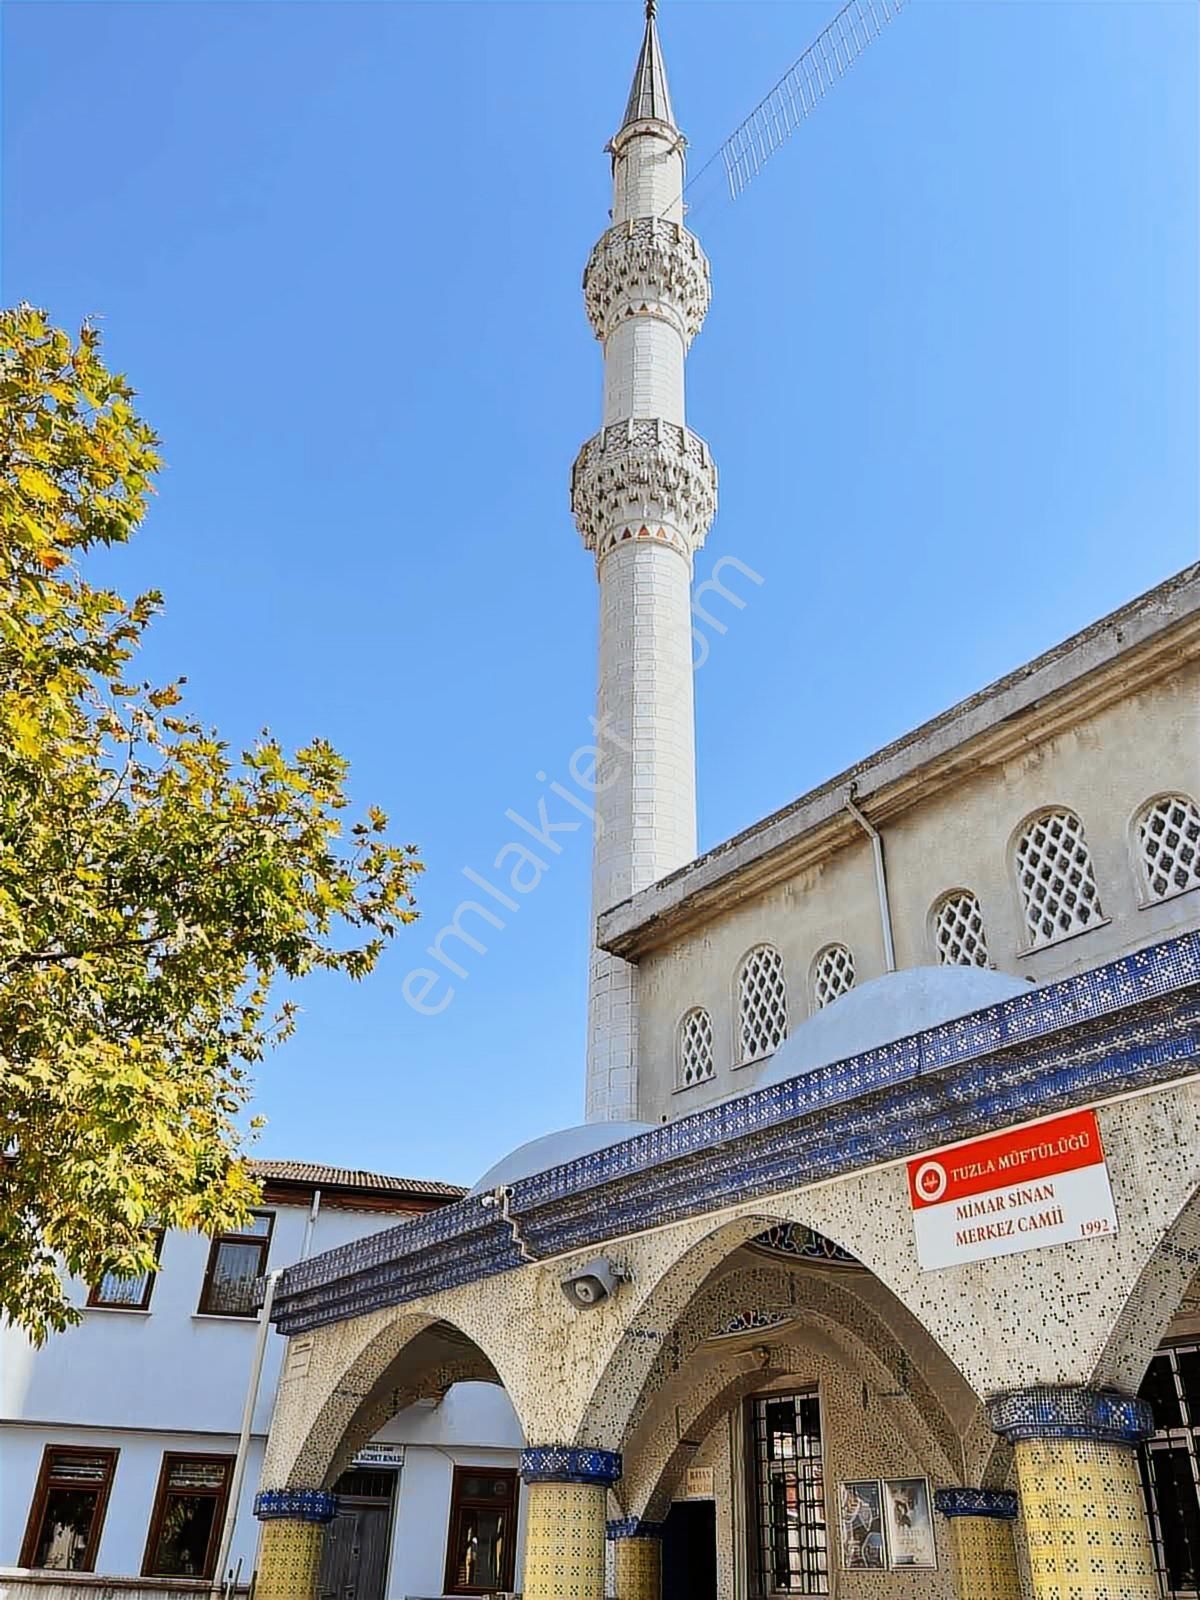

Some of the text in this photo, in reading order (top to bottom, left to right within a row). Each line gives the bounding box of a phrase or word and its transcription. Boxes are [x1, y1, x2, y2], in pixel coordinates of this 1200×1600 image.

[951, 1131, 1090, 1181] TUZLA MÜFTÜLÜĞÜ
[956, 1184, 1055, 1221] MİMAR SİNAN
[955, 1205, 1064, 1246] MERKEZ CAMİİ
[1080, 1219, 1110, 1236] 1992
